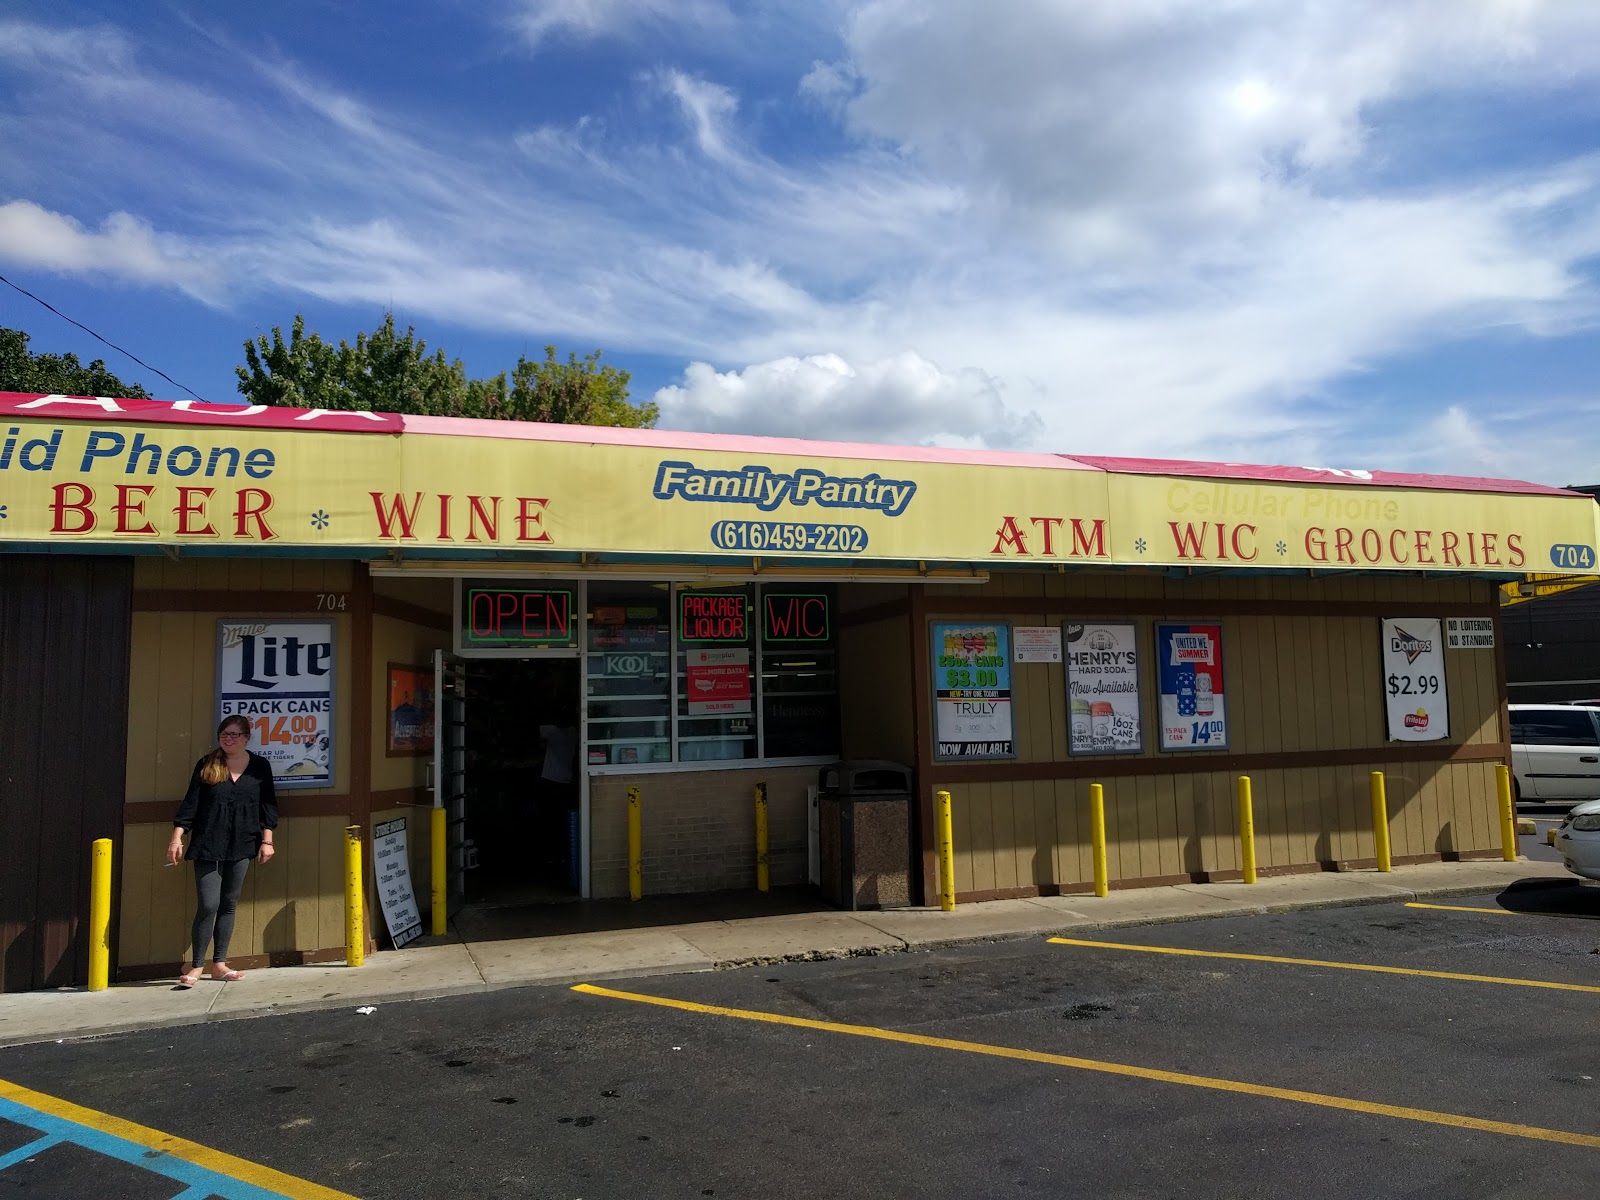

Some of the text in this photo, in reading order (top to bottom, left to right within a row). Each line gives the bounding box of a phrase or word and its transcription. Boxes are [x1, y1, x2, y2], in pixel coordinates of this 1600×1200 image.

[80, 430, 276, 479] Phone
[1166, 480, 1399, 521] Cellular Phone
[48, 482, 555, 544] BEER WINE
[715, 521, 863, 551] (616)459-2202
[991, 515, 1528, 569] ATM WIC GROCERIES
[1556, 545, 1592, 567] 704
[316, 594, 347, 611] 704
[683, 597, 744, 617] PACKAGE
[472, 593, 567, 637] OPEN
[767, 597, 825, 638] WIC
[683, 618, 744, 638] LIQUOR
[1448, 620, 1492, 631] NO LOITERING
[1175, 637, 1208, 649] UNITED WE
[1391, 637, 1432, 653] Doritos
[1449, 635, 1493, 646] NO STANDING
[235, 634, 331, 690] Lite
[974, 655, 1004, 667] CANS
[1068, 651, 1136, 666] HENRY'S
[1178, 649, 1209, 659] SUMMER
[607, 656, 653, 673] KOOL
[727, 667, 745, 675] DATA!
[1078, 666, 1127, 674] HARD SODA
[947, 669, 998, 688] $3.00
[1388, 673, 1439, 698] $2.99
[973, 690, 983, 698] ONE
[1069, 680, 1092, 697] Now
[238, 701, 283, 714] PACK
[288, 700, 330, 713] CANS
[953, 702, 997, 714] TRULY
[1111, 727, 1134, 738] CANS
[940, 742, 1010, 756] NOW AVAILABLE
